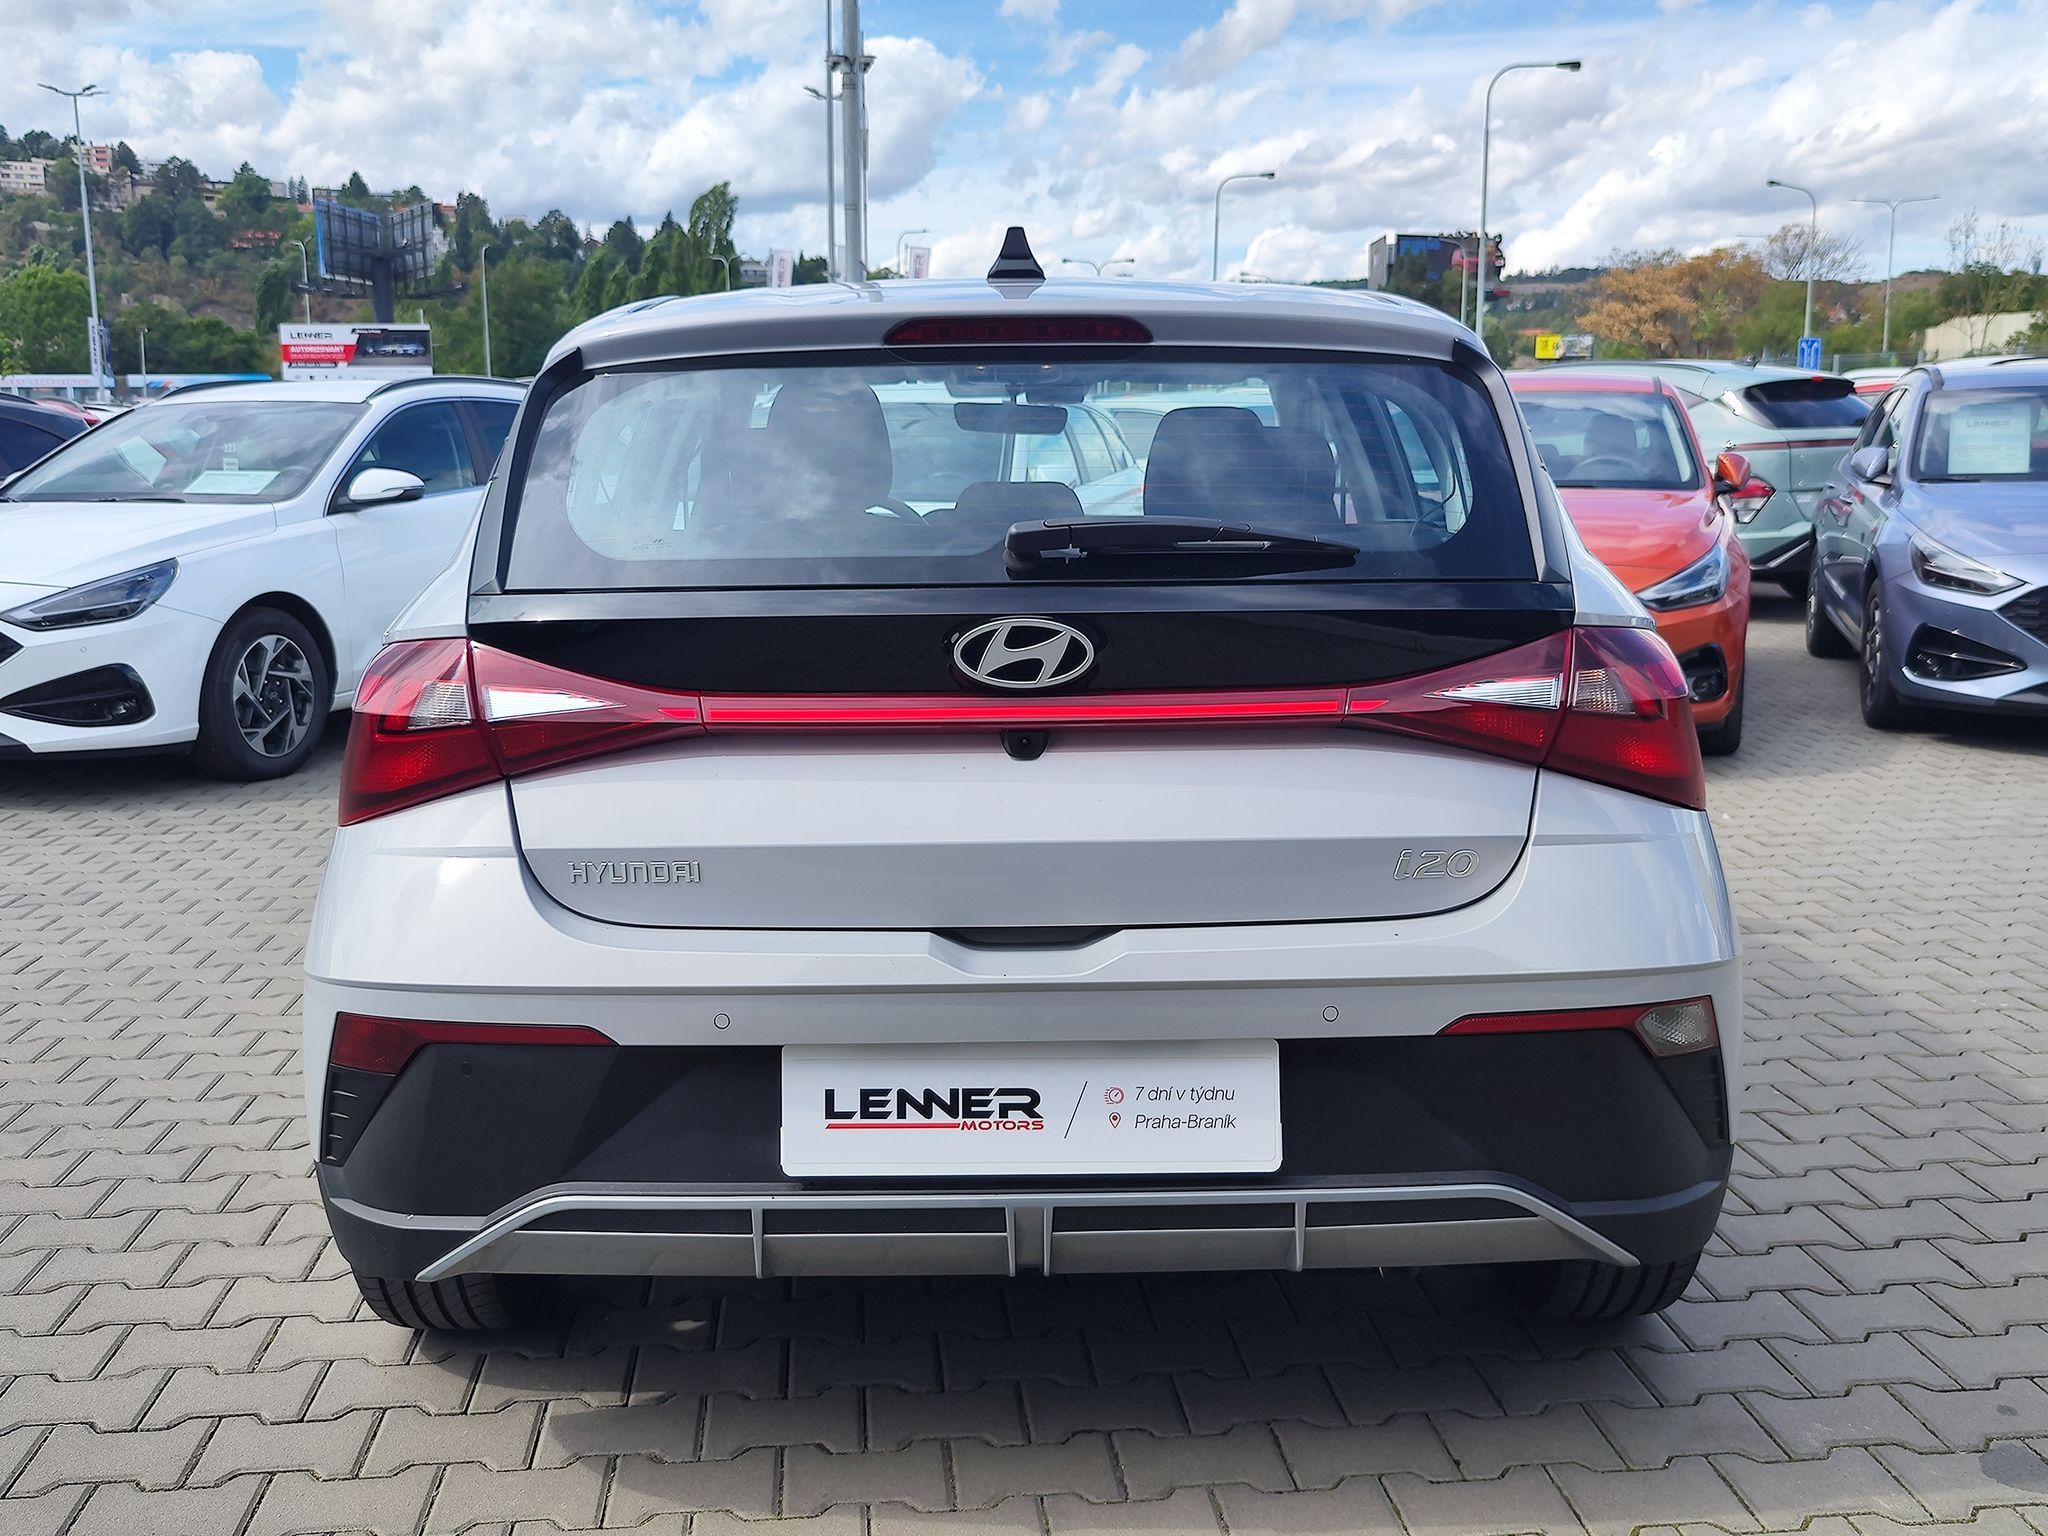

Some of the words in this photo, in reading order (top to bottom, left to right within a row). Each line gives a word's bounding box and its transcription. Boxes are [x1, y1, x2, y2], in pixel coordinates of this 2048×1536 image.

[290, 332, 333, 340] LENNER
[567, 860, 702, 884] HYUNDAI
[1393, 848, 1480, 880] i20
[825, 1088, 1044, 1119] LENNER
[1135, 1086, 1145, 1101] 7
[1147, 1085, 1174, 1101] dní
[1175, 1088, 1187, 1101] v
[1190, 1085, 1236, 1105] týdnu
[960, 1120, 1045, 1131] MOTORS
[1134, 1113, 1238, 1129] Praha-Braník
